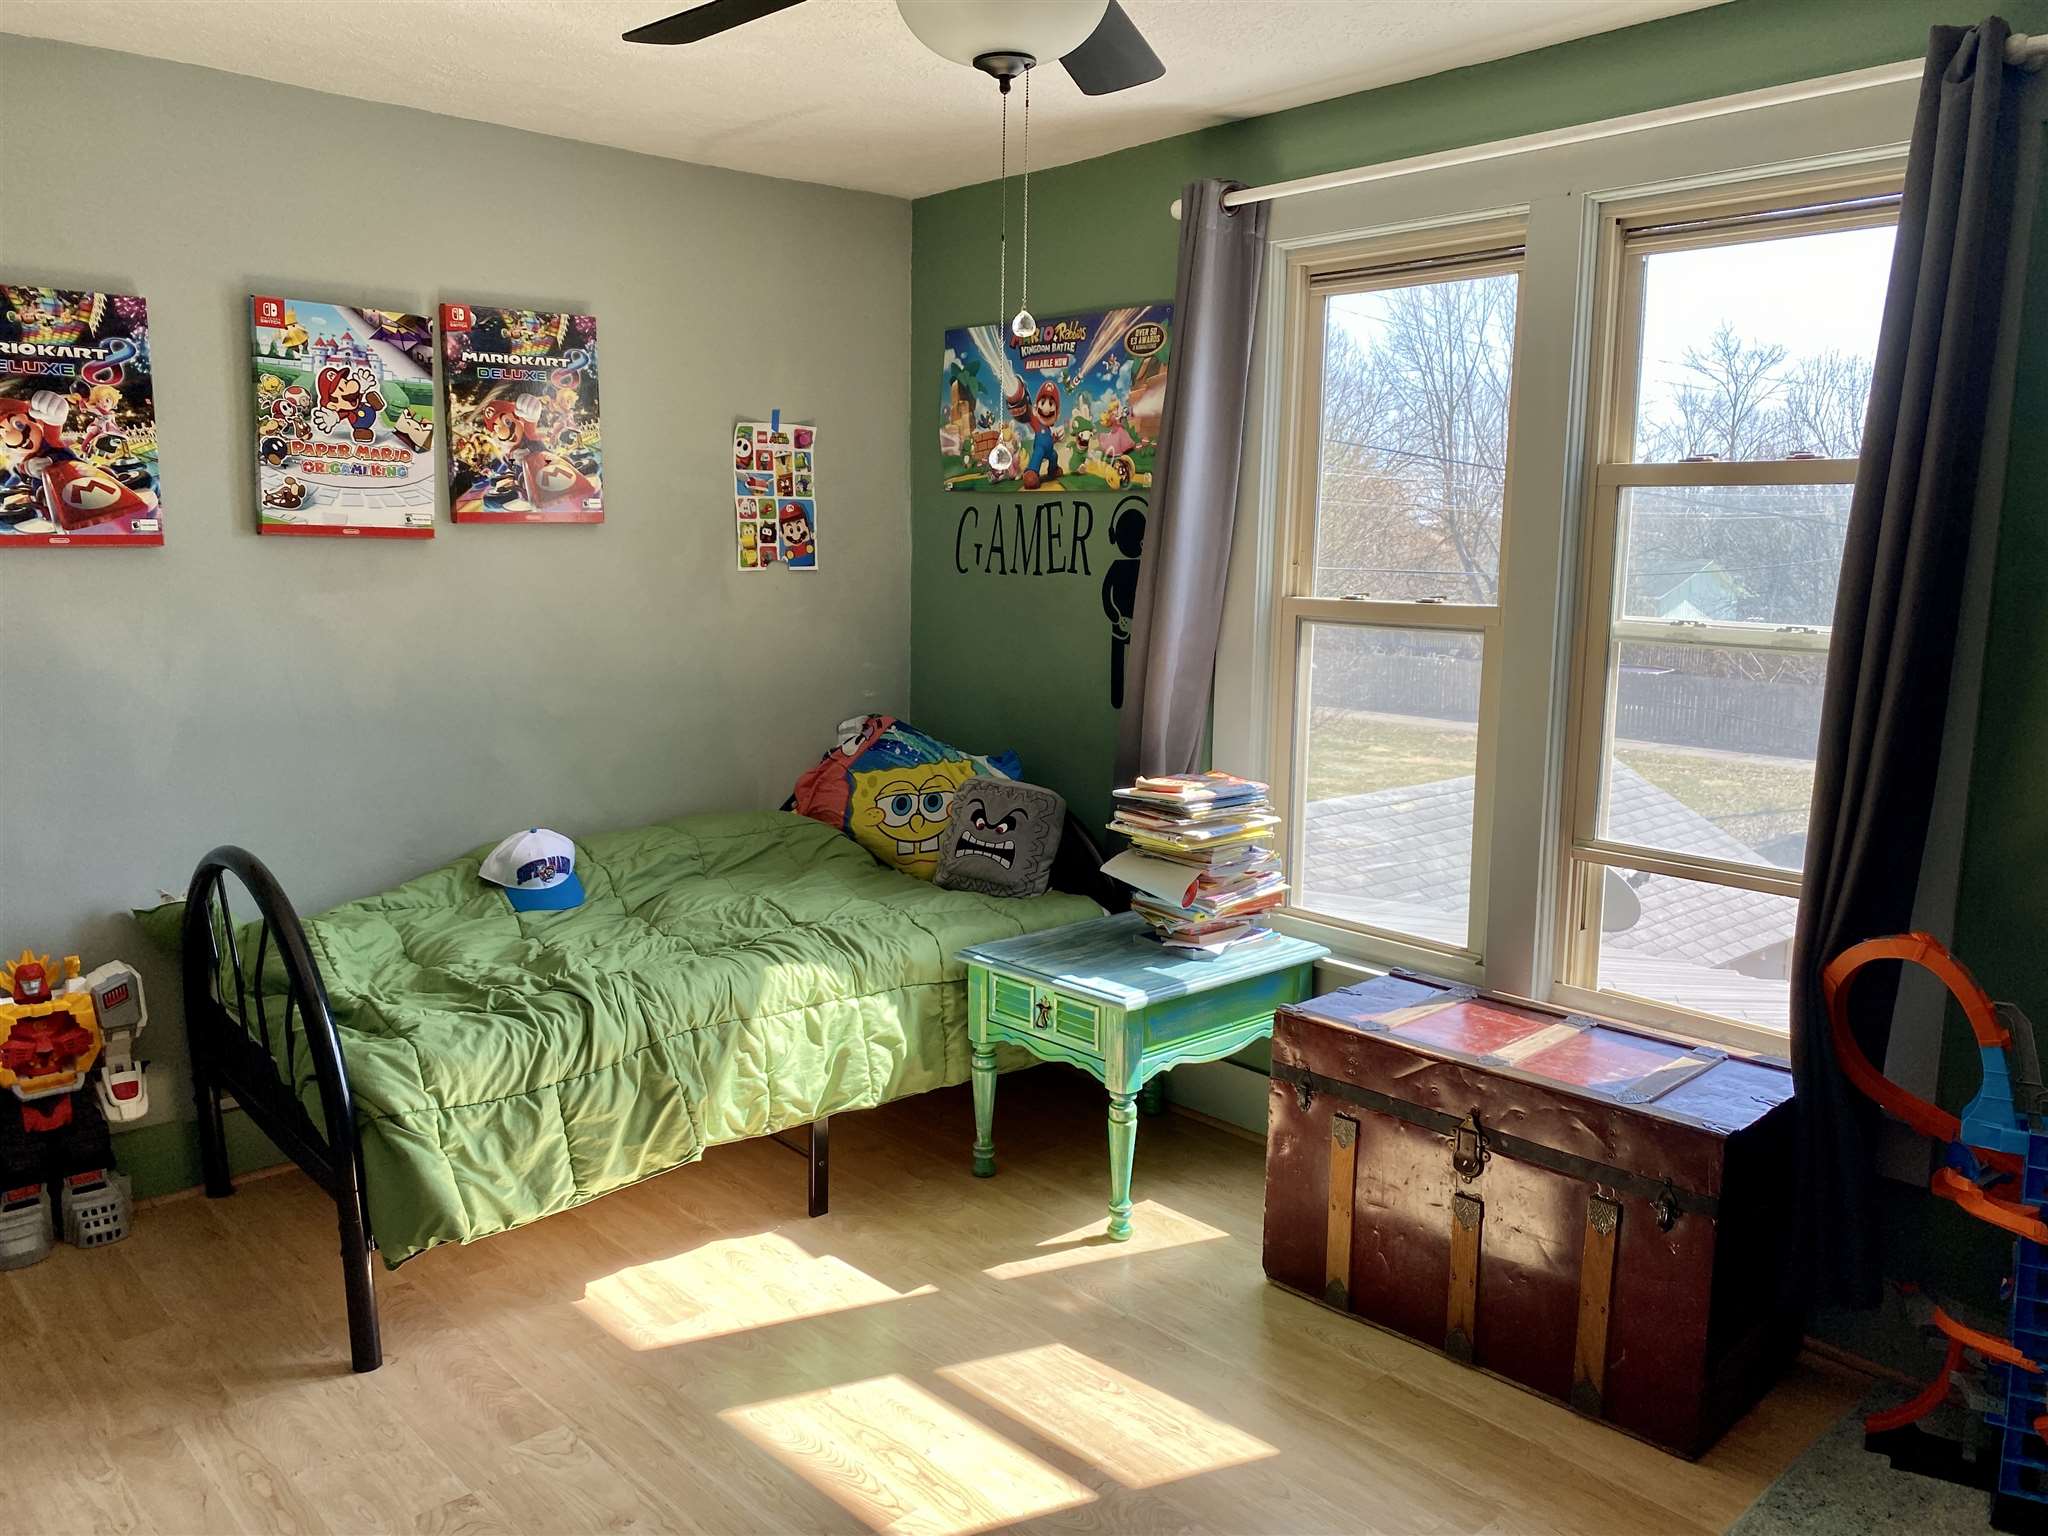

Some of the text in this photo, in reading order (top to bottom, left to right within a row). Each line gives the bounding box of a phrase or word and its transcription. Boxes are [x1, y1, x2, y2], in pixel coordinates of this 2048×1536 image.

[1021, 341, 1076, 357] KINGDOM BATTLE
[81, 337, 137, 385] 8
[551, 348, 590, 389] 8
[477, 367, 547, 382] DELUXE
[290, 440, 412, 463] PAPER MARIO
[302, 460, 408, 478] ORIGAMI KING
[955, 501, 1093, 576] GAMER
